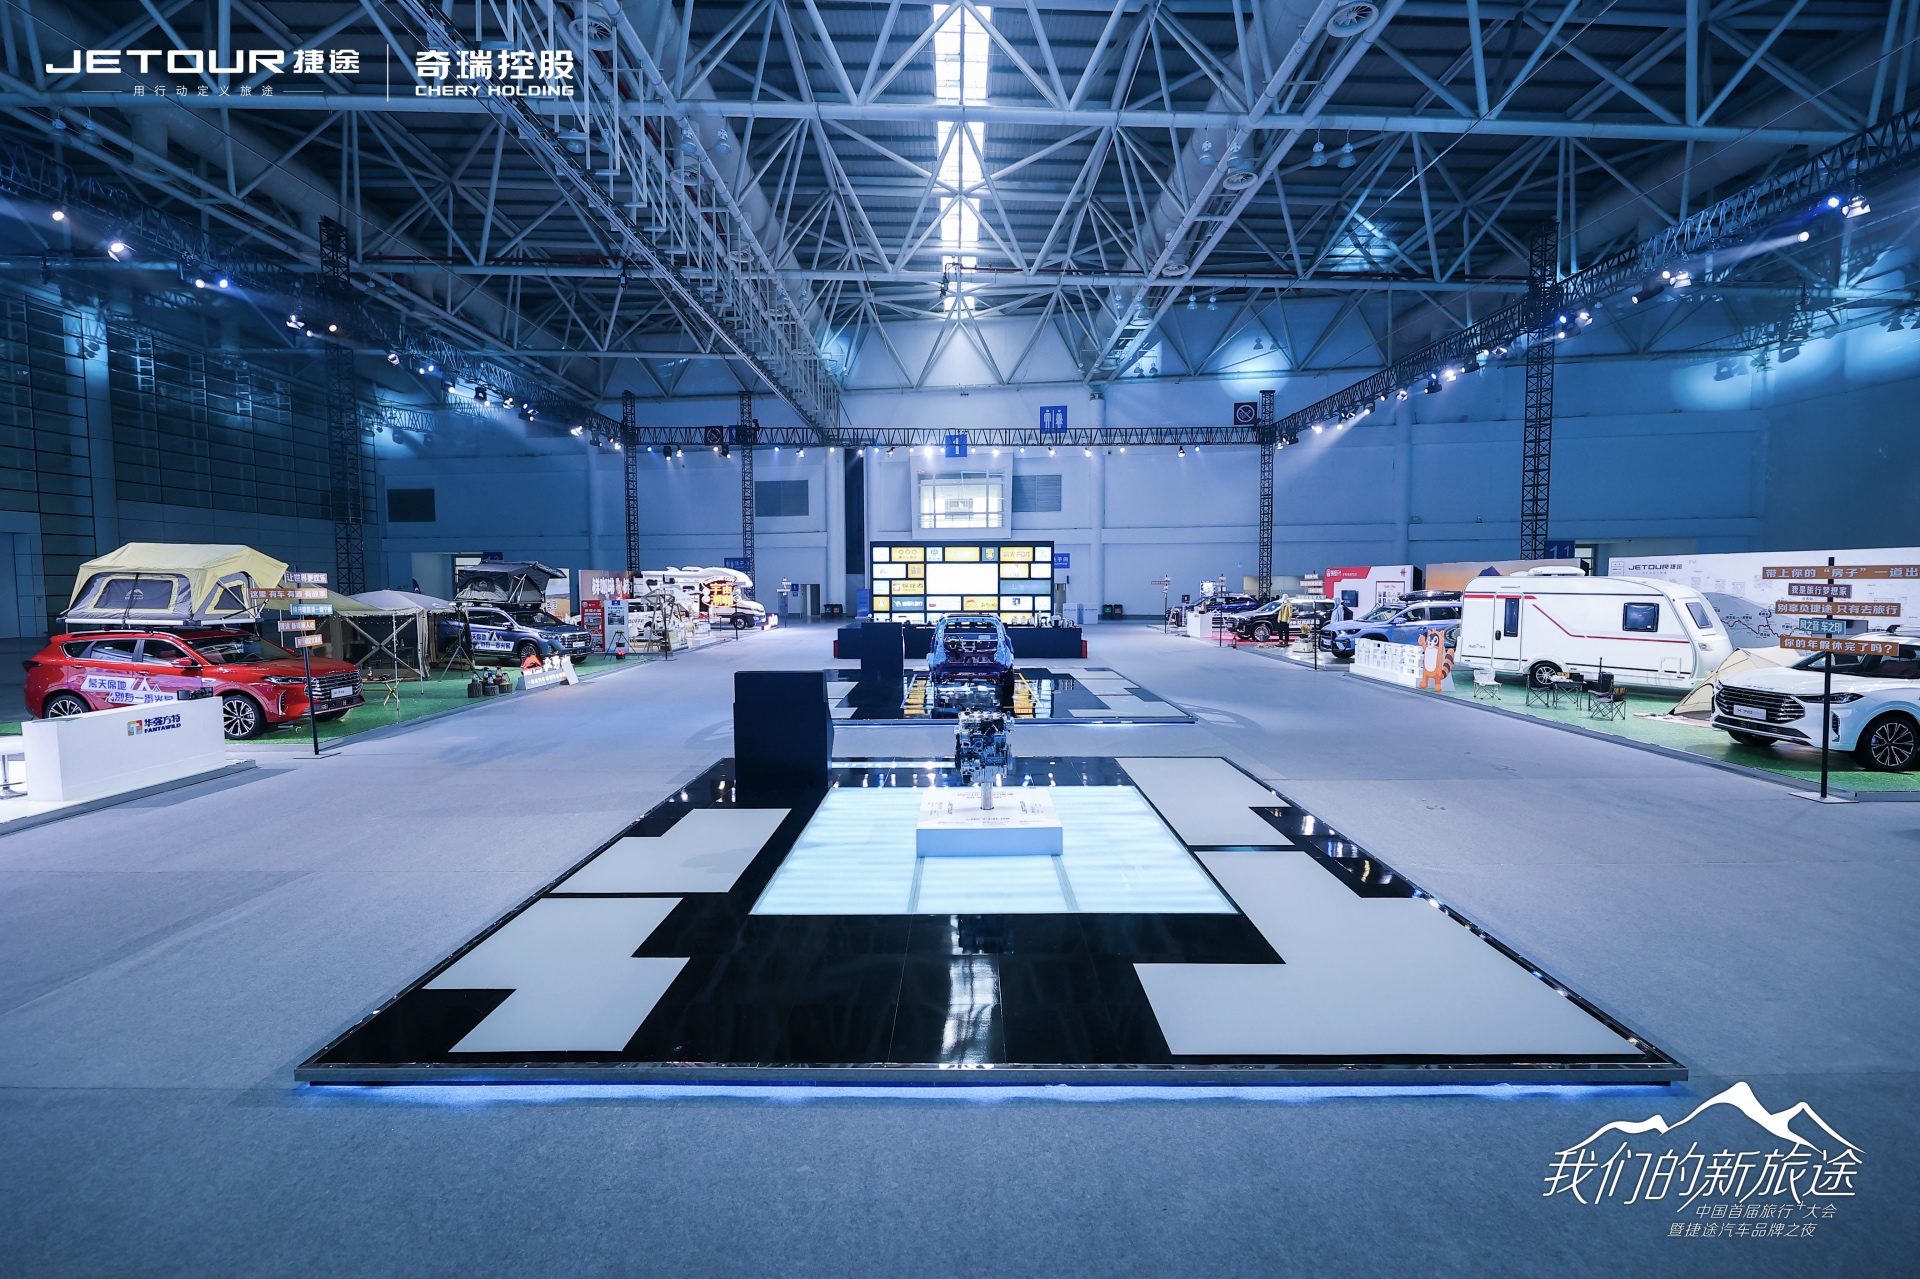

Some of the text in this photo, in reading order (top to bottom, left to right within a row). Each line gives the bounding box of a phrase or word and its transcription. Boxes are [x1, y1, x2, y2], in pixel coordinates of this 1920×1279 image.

[250, 590, 266, 598] 这里
[269, 590, 285, 598] 有车
[1791, 585, 1848, 596] 我是旅行梦想家
[1777, 603, 1898, 615] 别辜负捷途 只有去旅行
[1801, 619, 1842, 633] 风之音 车之印
[1784, 638, 1893, 654] 你的年假休完了吗?
[88, 678, 127, 690] 幕天席地
[144, 714, 181, 728] 华强方特
[144, 723, 181, 734] FANTAWILD
